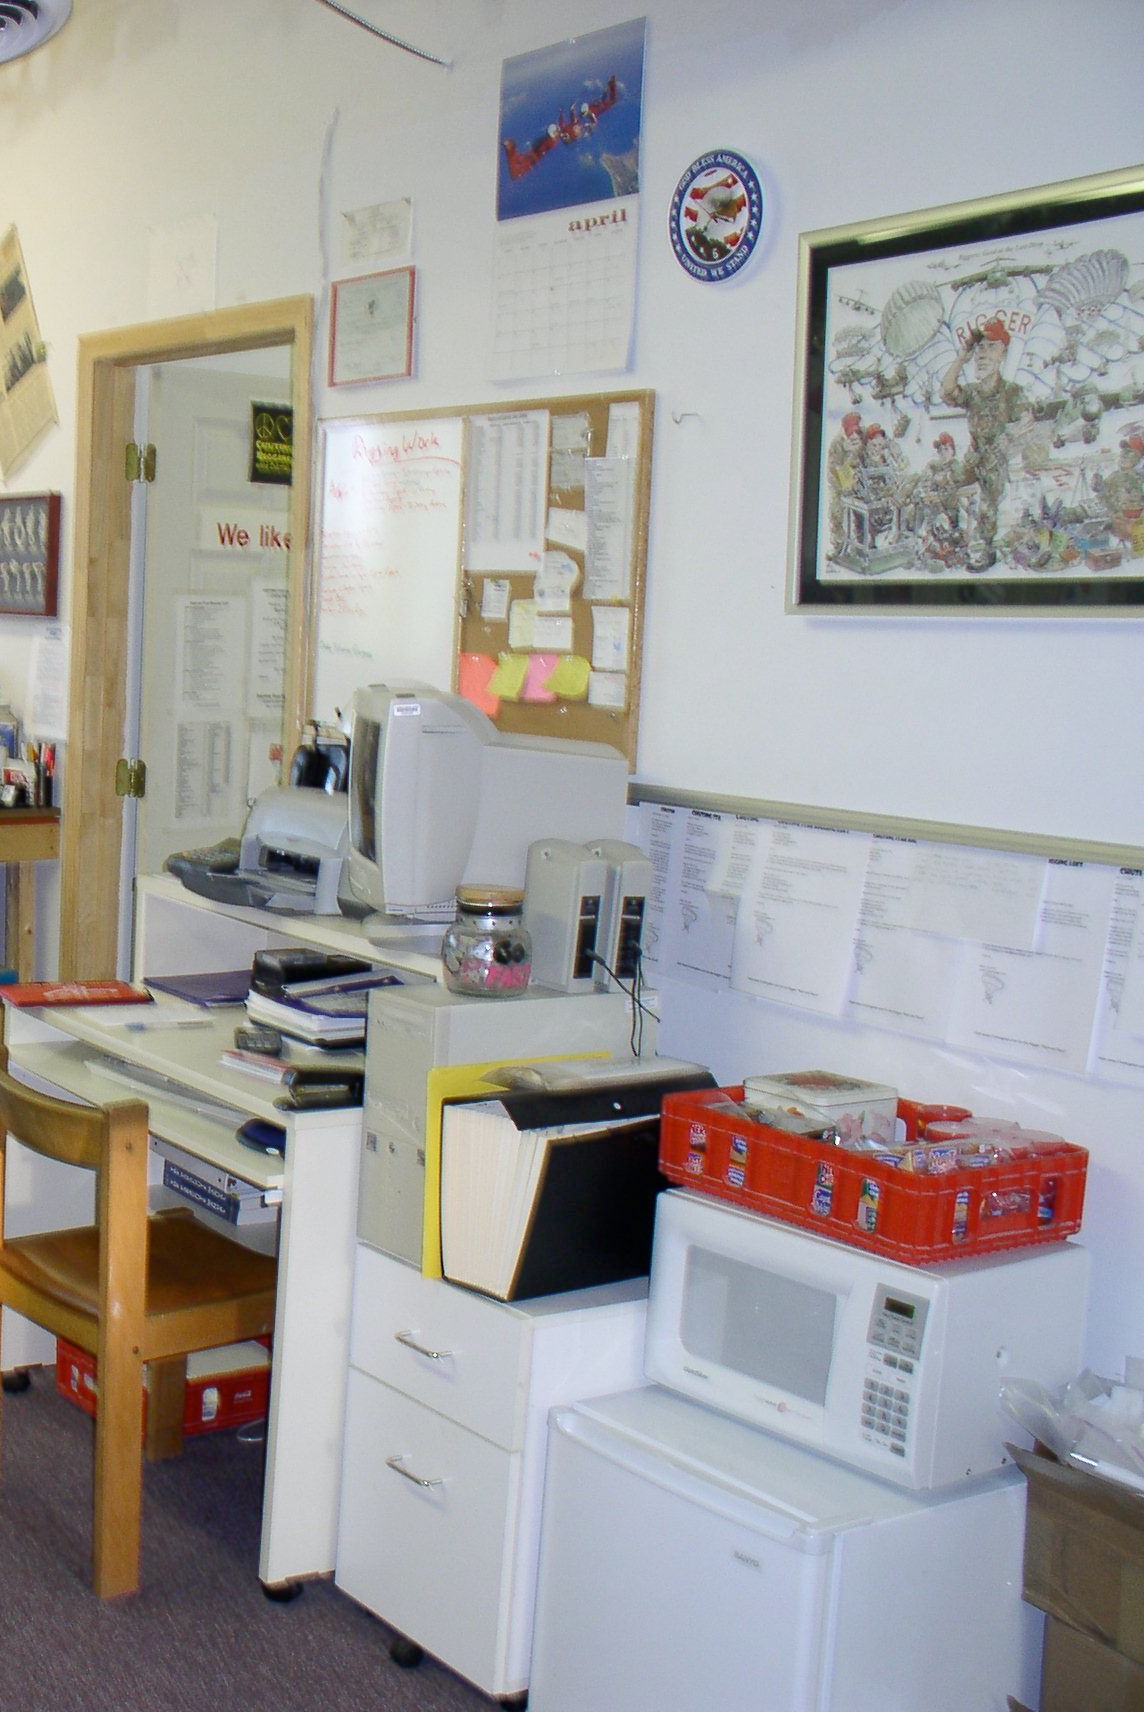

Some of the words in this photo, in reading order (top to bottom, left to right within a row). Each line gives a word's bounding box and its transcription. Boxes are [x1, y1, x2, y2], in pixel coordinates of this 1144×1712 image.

[568, 208, 627, 231] april
[726, 244, 748, 271] STAND
[217, 522, 250, 547] We
